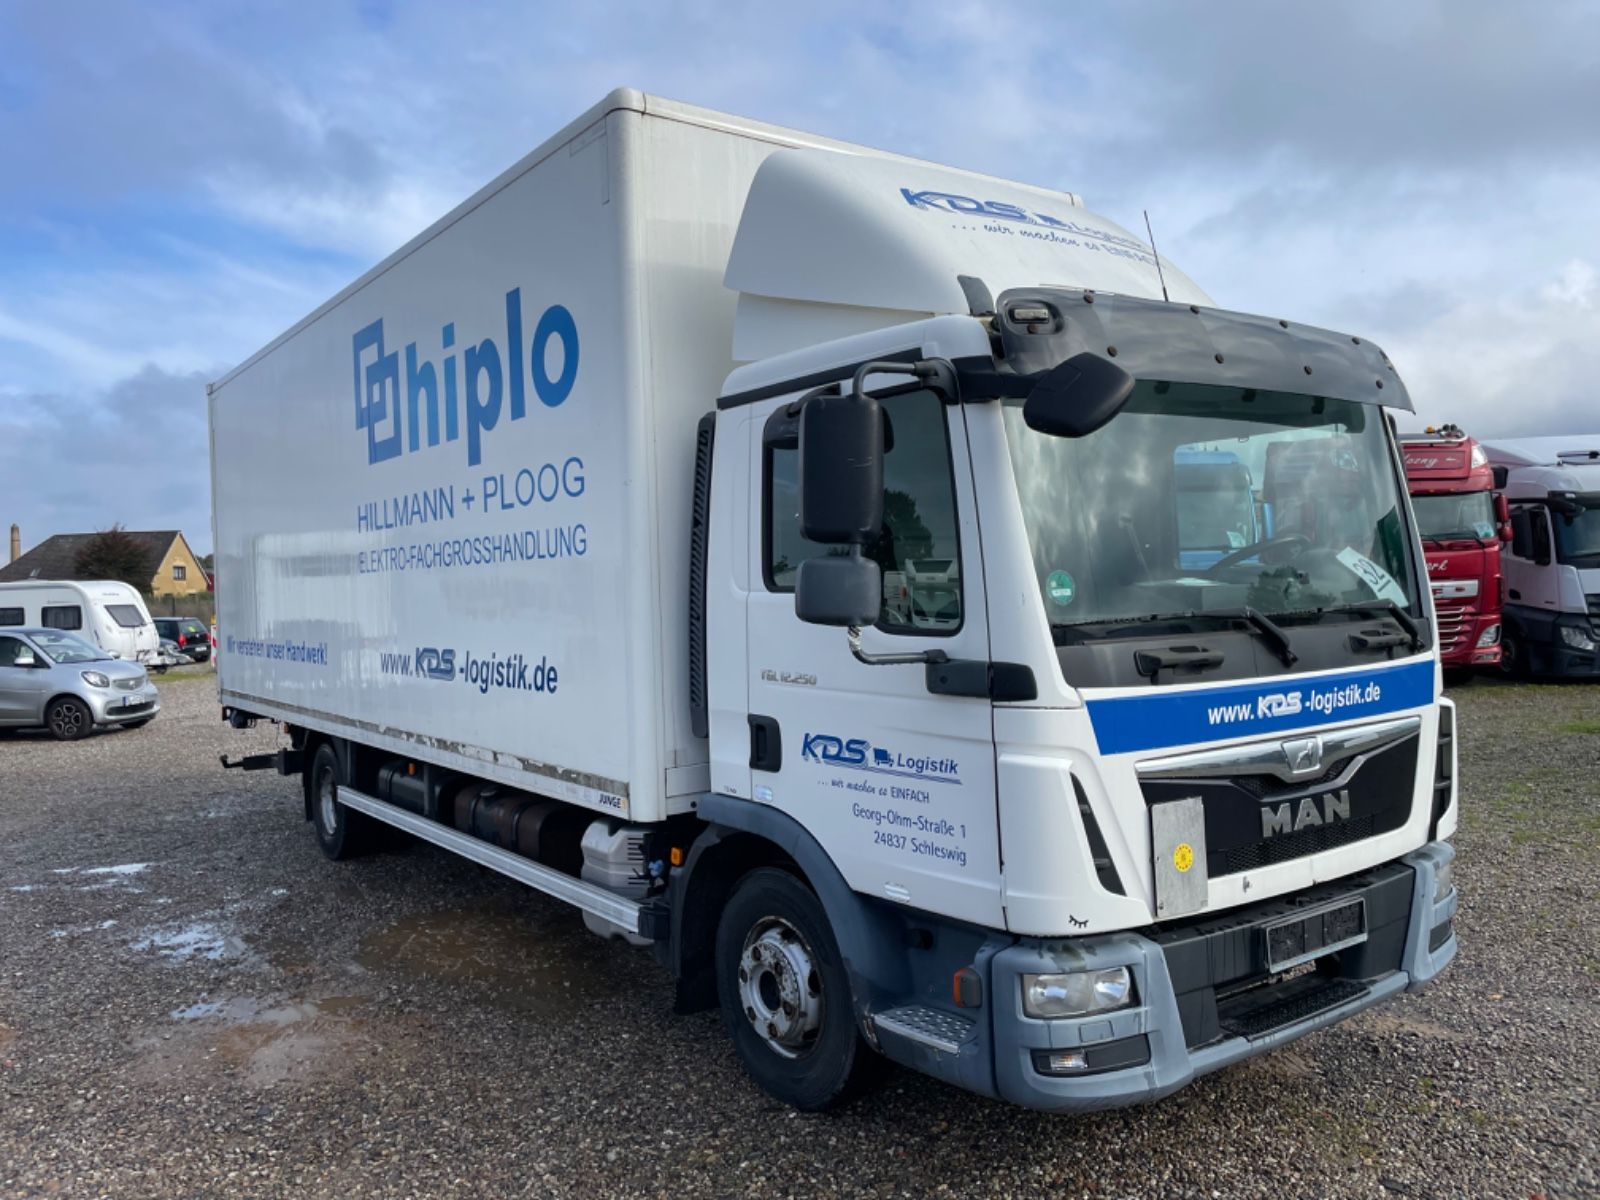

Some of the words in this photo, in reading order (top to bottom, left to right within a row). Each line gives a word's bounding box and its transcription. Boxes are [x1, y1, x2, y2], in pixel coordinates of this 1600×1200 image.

[899, 187, 1037, 224] KDS
[405, 287, 579, 467] hiplo
[357, 485, 454, 533] HILLMANN
[462, 488, 475, 510] +
[484, 456, 585, 513] PLOOG
[359, 523, 587, 573] ELEKTRO-FACHGROSSHANDLUNG
[286, 640, 328, 666] Handwerk!
[801, 732, 871, 768] KDS
[897, 752, 958, 774] Logistik
[890, 786, 930, 803] EINFACH
[1261, 789, 1350, 838] MAN
[852, 803, 955, 837] Georg-Ohm-Straße
[874, 831, 907, 851] 24837
[910, 837, 967, 866] Schleswig
